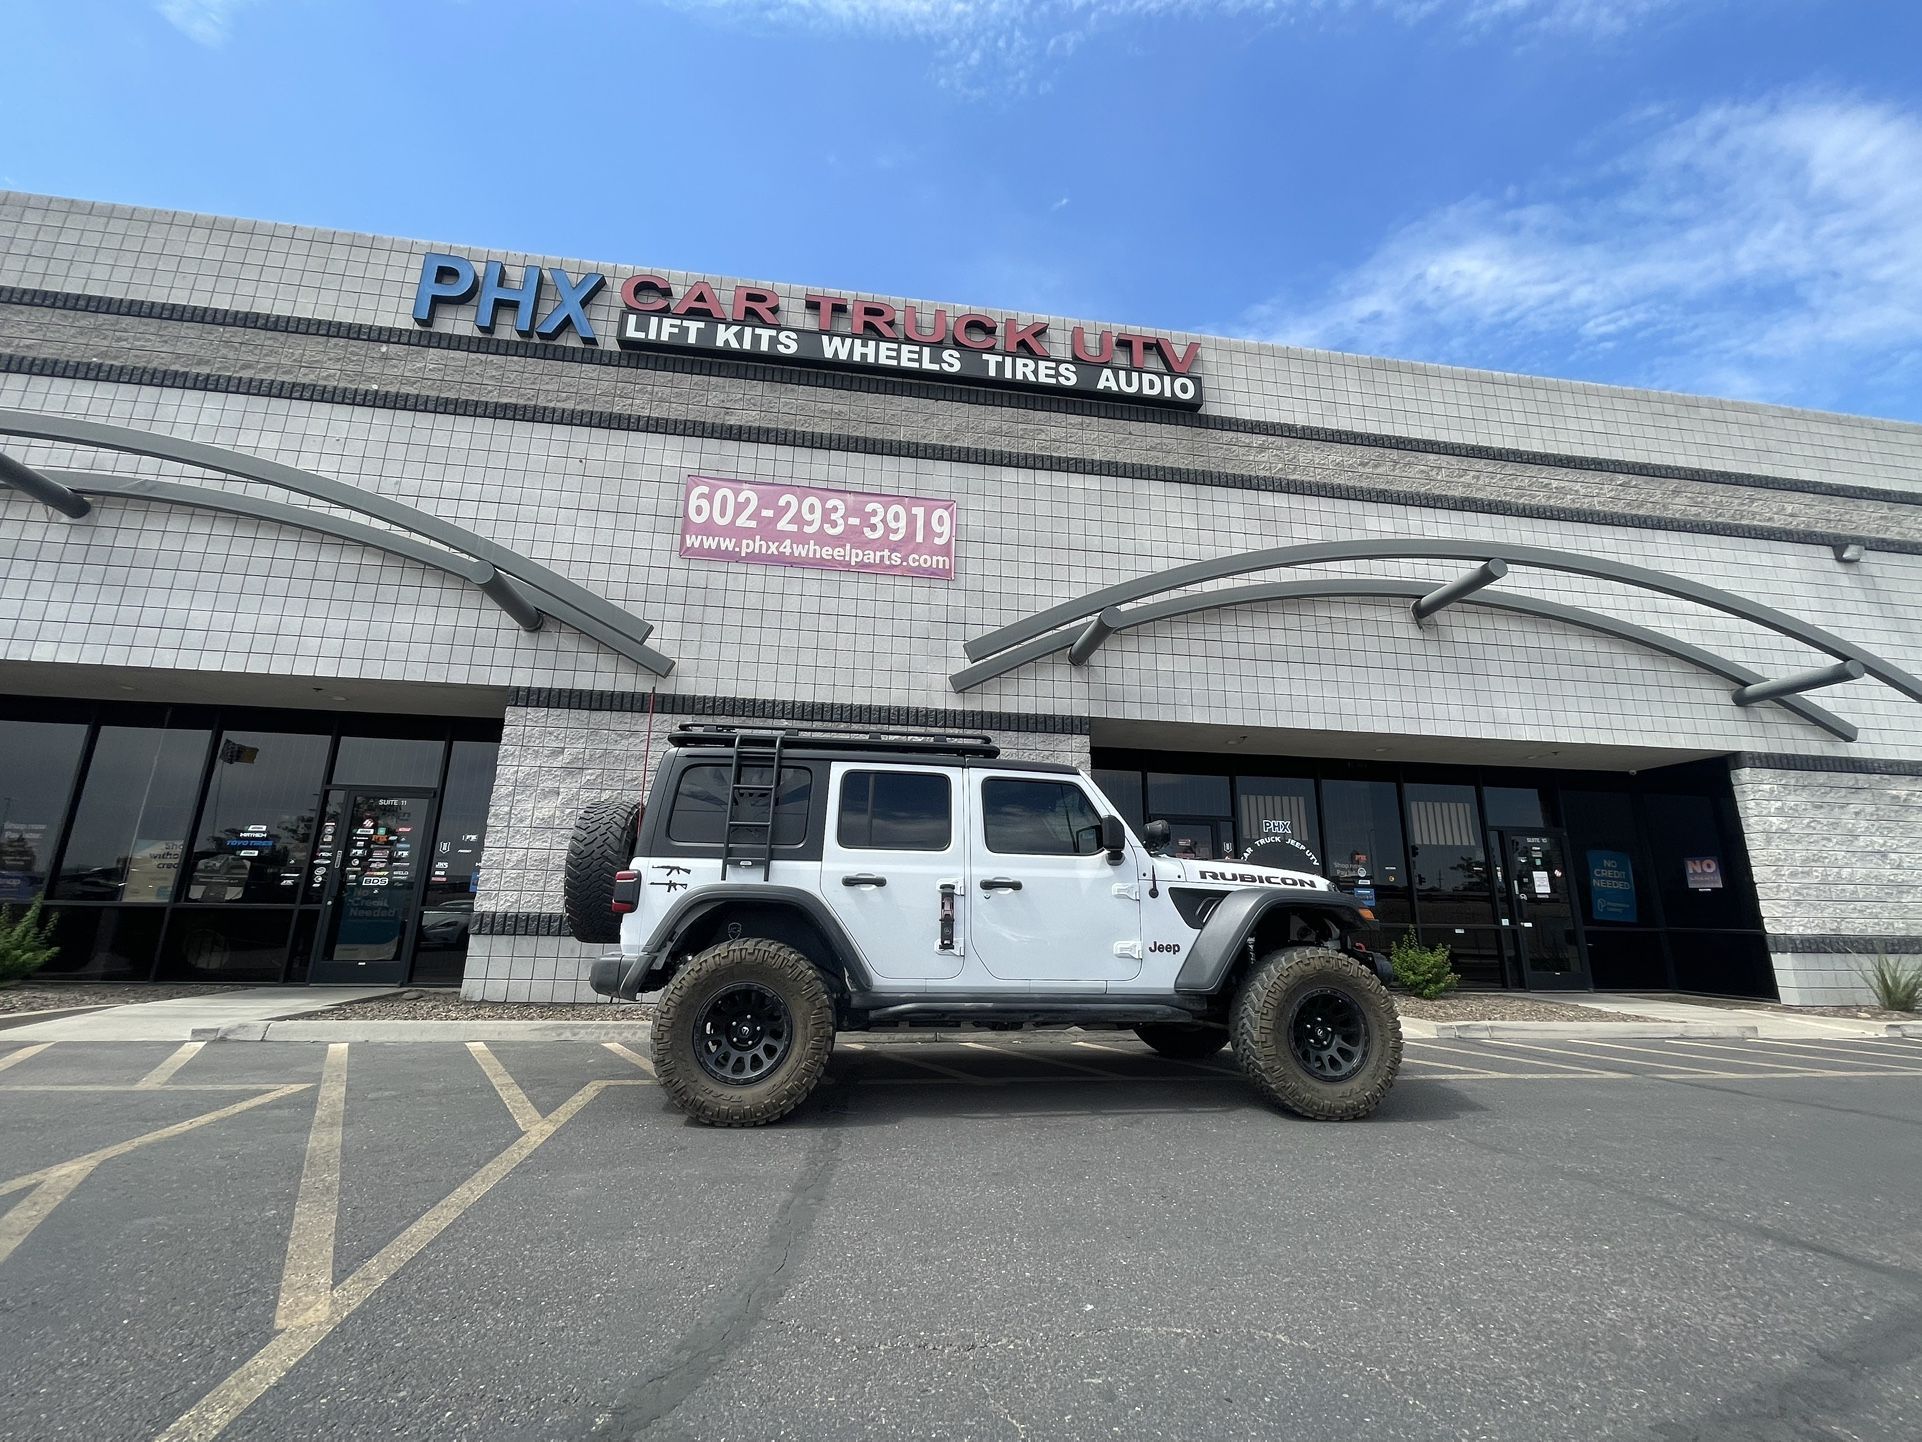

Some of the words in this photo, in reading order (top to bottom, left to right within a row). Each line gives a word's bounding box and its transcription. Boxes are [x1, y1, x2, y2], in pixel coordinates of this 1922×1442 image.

[413, 253, 606, 345] PHX
[620, 274, 781, 325] CAR
[804, 293, 1050, 358] TRUCK
[1072, 325, 1201, 375] UTV
[625, 314, 705, 346] LIFT
[716, 322, 799, 356] KITS
[820, 334, 961, 374] WHEELS
[982, 353, 1077, 387] TIRES
[1096, 367, 1195, 400] AUDIO
[687, 484, 953, 546] 602-293-3919
[684, 532, 951, 570] www.phx4wheelparts.com
[1262, 819, 1292, 834] PHX
[1254, 836, 1282, 847] TRUCK
[1285, 838, 1307, 851] JEEP
[1305, 849, 1320, 866] UTV
[1602, 859, 1617, 869] NO
[1687, 859, 1716, 874] NO
[1198, 869, 1317, 889] RUBICON
[1593, 868, 1627, 880] CREDIT
[1592, 878, 1631, 890] NEEDED
[350, 907, 395, 917] Needed
[1148, 941, 1181, 956] Jeep
